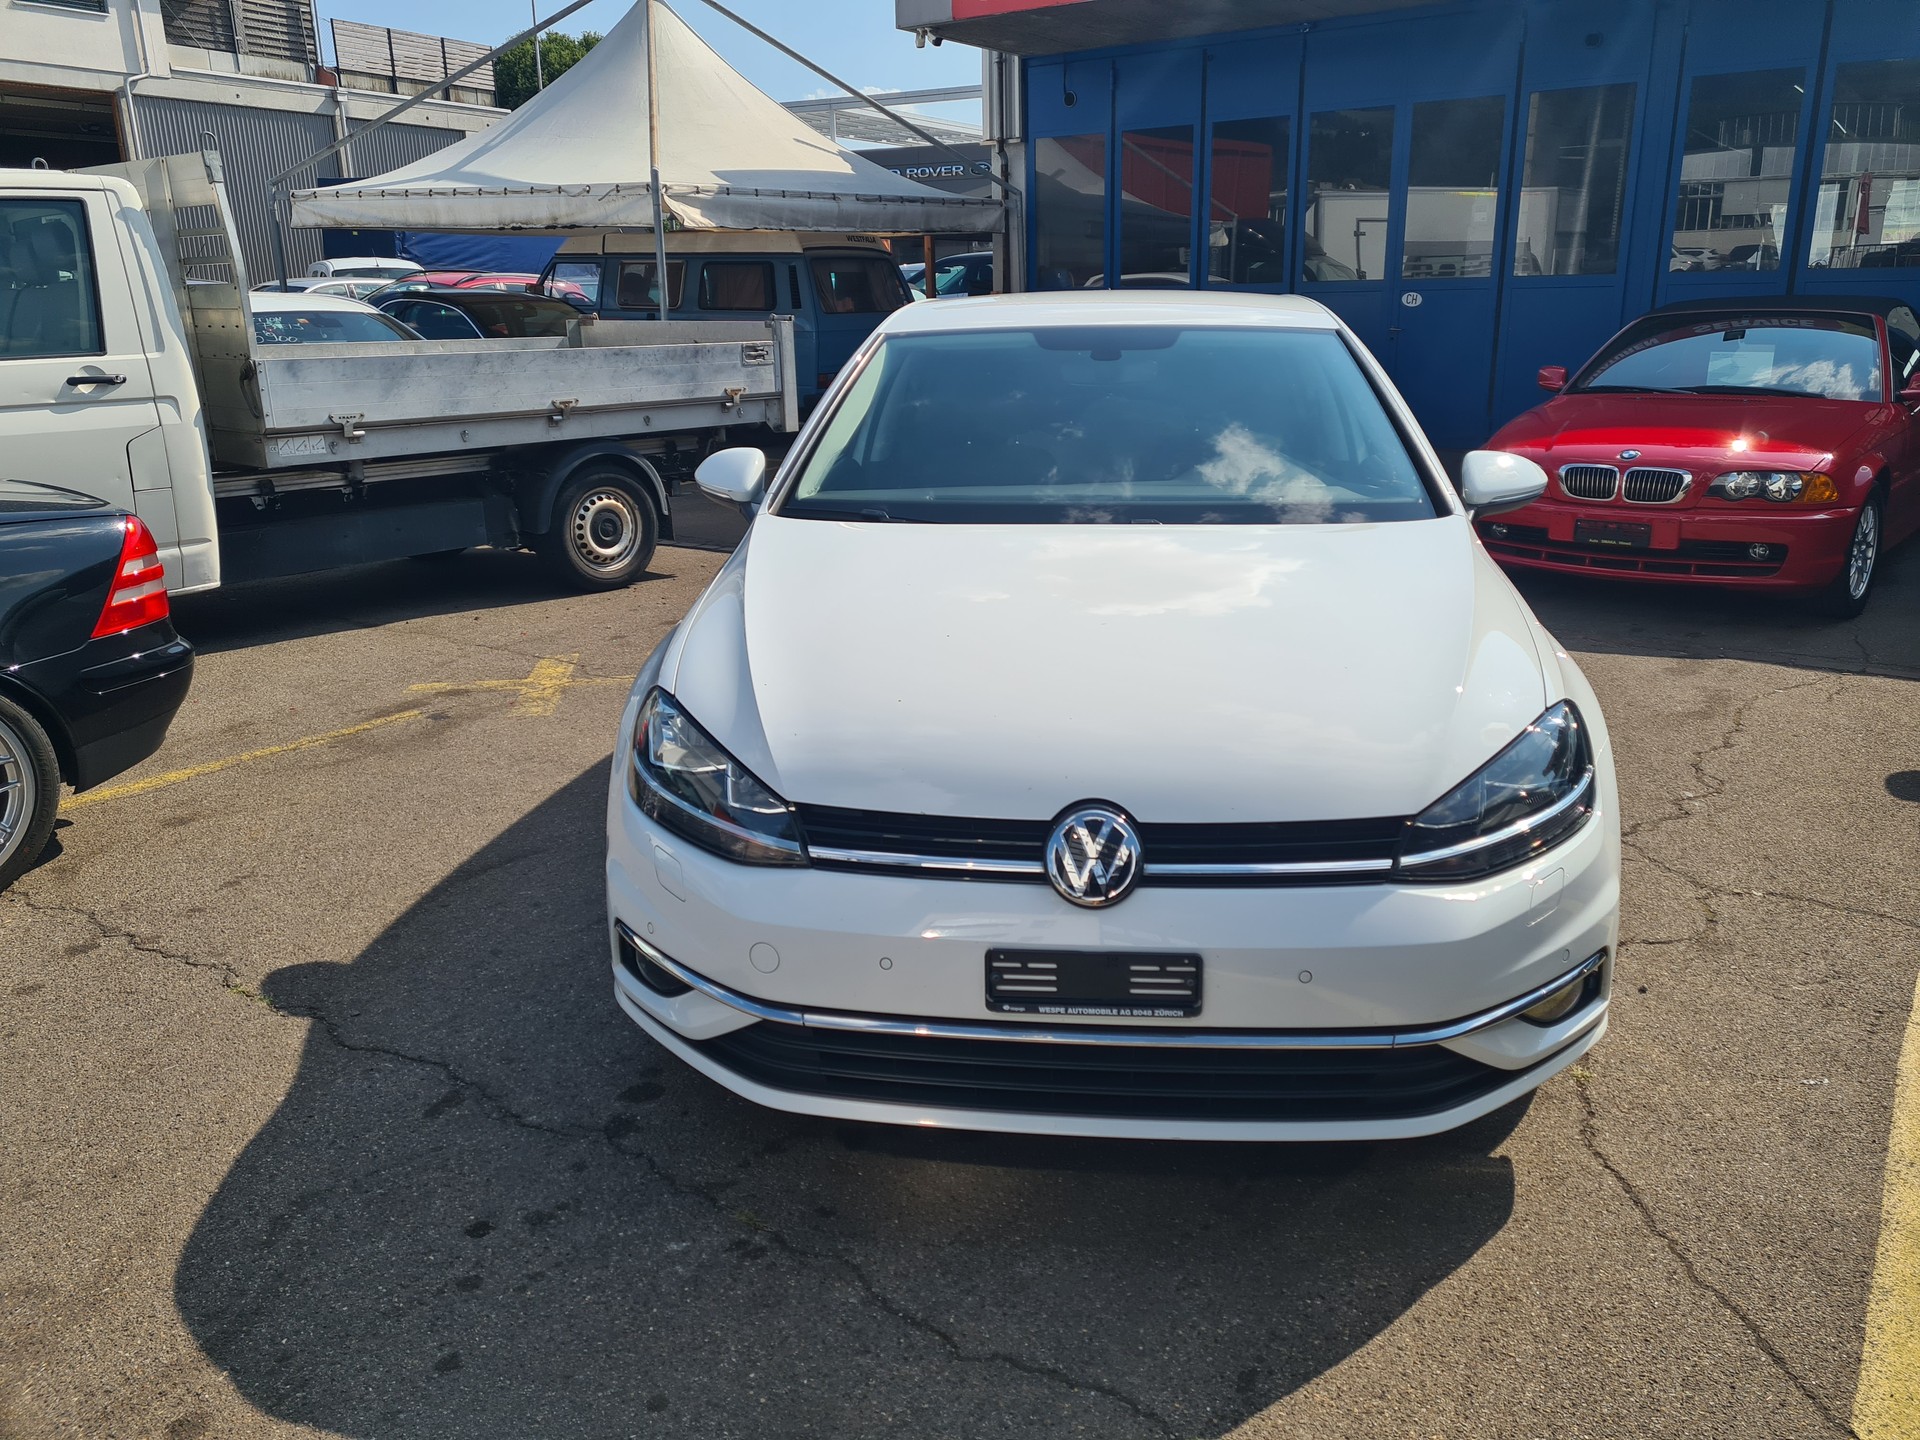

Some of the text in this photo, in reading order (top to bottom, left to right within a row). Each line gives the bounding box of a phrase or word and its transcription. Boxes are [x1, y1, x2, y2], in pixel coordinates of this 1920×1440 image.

[906, 165, 964, 179] ROVER
[1406, 294, 1418, 304] CH
[1039, 1006, 1065, 1014] WESPE
[1067, 1007, 1118, 1016] AUTOMOBILE
[1154, 1009, 1184, 1018] ZÜRICH
